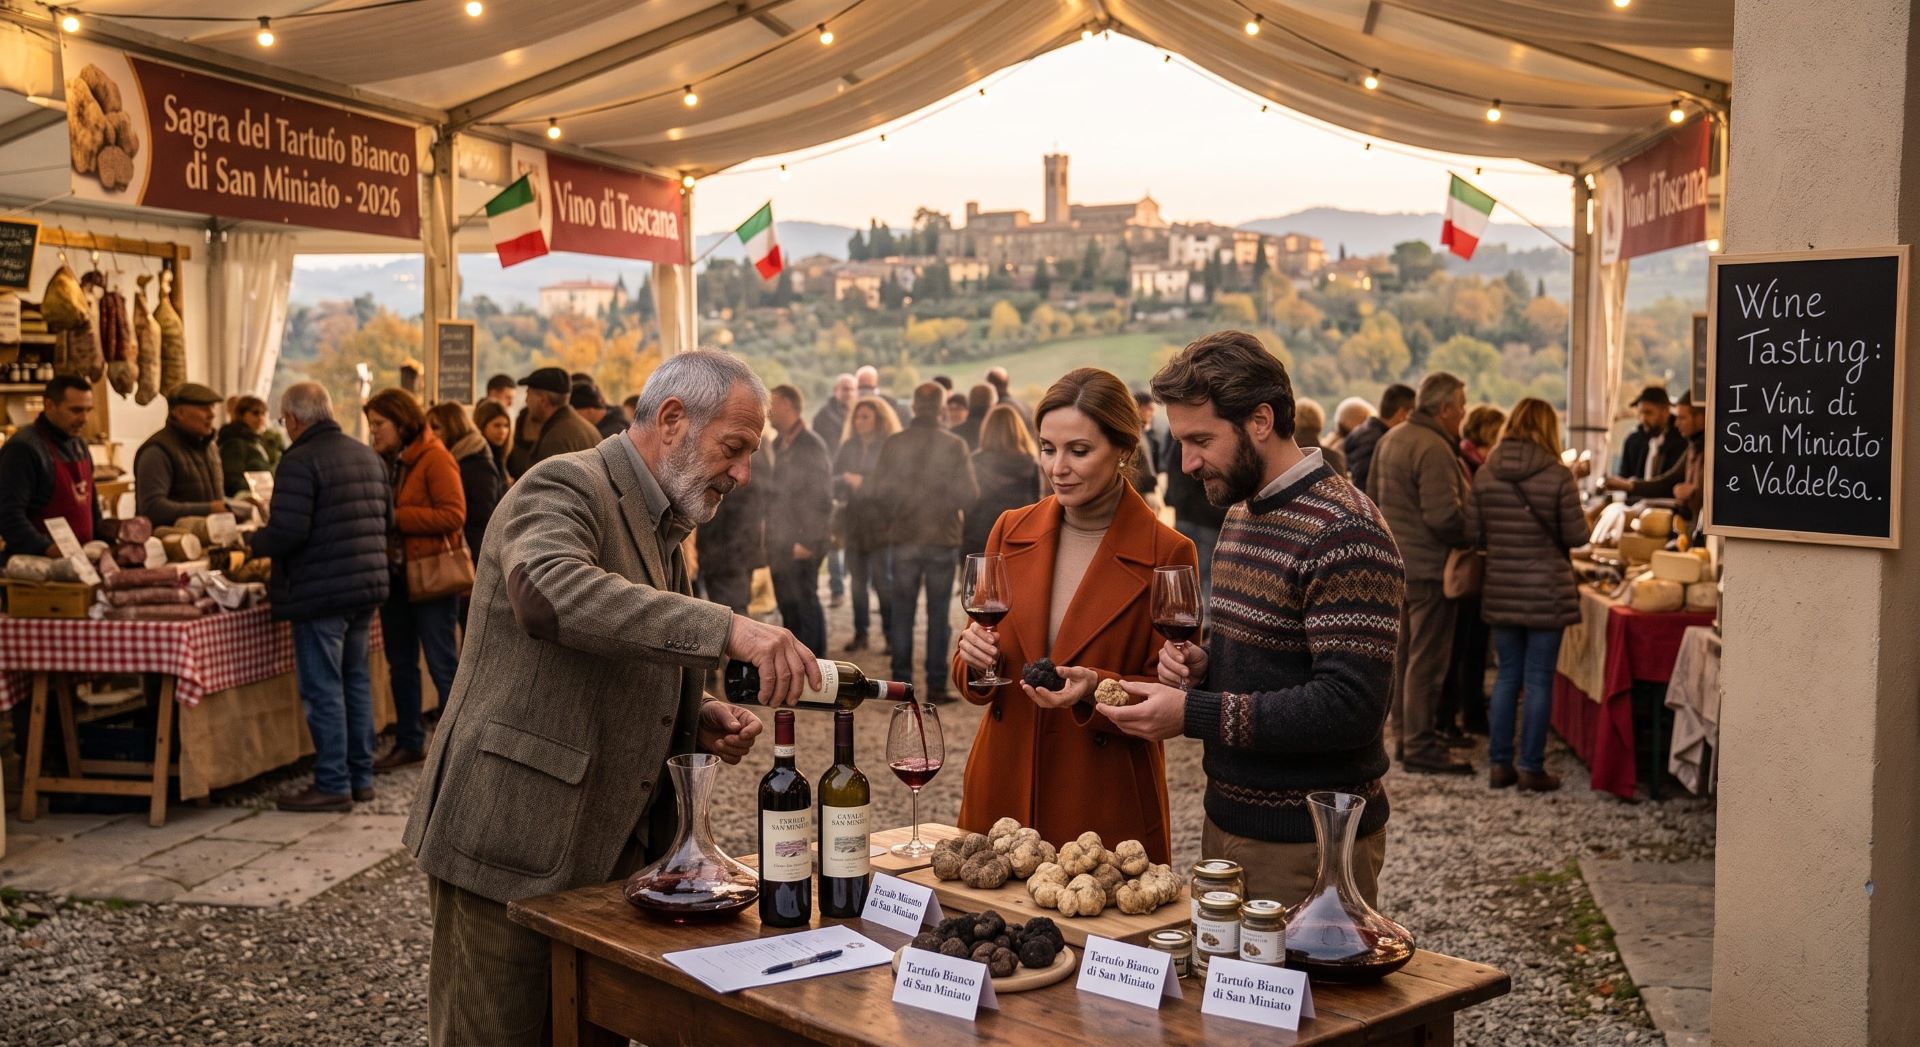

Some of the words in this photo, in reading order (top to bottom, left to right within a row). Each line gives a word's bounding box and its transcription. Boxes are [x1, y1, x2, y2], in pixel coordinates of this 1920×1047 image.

[164, 94, 230, 149] Sagra
[237, 108, 270, 150] del
[275, 118, 345, 164] Tartufo
[351, 134, 410, 176] Bianco
[186, 150, 208, 190] di
[216, 156, 256, 197] San
[263, 164, 340, 209] Miniato
[357, 181, 400, 218] 2026
[1624, 183, 1645, 228] Vino
[1646, 170, 1656, 222] di
[1657, 167, 1706, 217] Toscana
[554, 180, 596, 227] Vino
[601, 187, 616, 230] di
[617, 192, 679, 240] Toscana
[1735, 278, 1826, 319] Wine
[1737, 327, 1881, 384] Tasting:
[1728, 383, 1748, 413] I
[1762, 382, 1814, 414] Vini
[1828, 386, 1857, 416] di
[1724, 422, 1773, 454] San
[1781, 423, 1881, 458] Miniato
[1726, 475, 1740, 492] e
[1752, 461, 1882, 501] Valdelsa.
[870, 897, 878, 908] di
[878, 900, 891, 912] San
[892, 904, 919, 921] Miniato
[907, 961, 940, 979] Tartufo
[942, 970, 975, 987] Bianco
[1087, 966, 1097, 976] di
[1098, 968, 1116, 981] San
[1118, 972, 1155, 990] Miniato
[1090, 950, 1124, 967] Tartufo
[1126, 958, 1159, 975] Bianco
[903, 978, 912, 988] di
[914, 979, 932, 993] San
[934, 984, 971, 1002] Miniato
[1212, 988, 1224, 999] di
[1225, 990, 1246, 1003] San
[1249, 994, 1291, 1011] Miniato
[1215, 972, 1254, 988] Tartufo
[1257, 979, 1294, 996] Bianco
